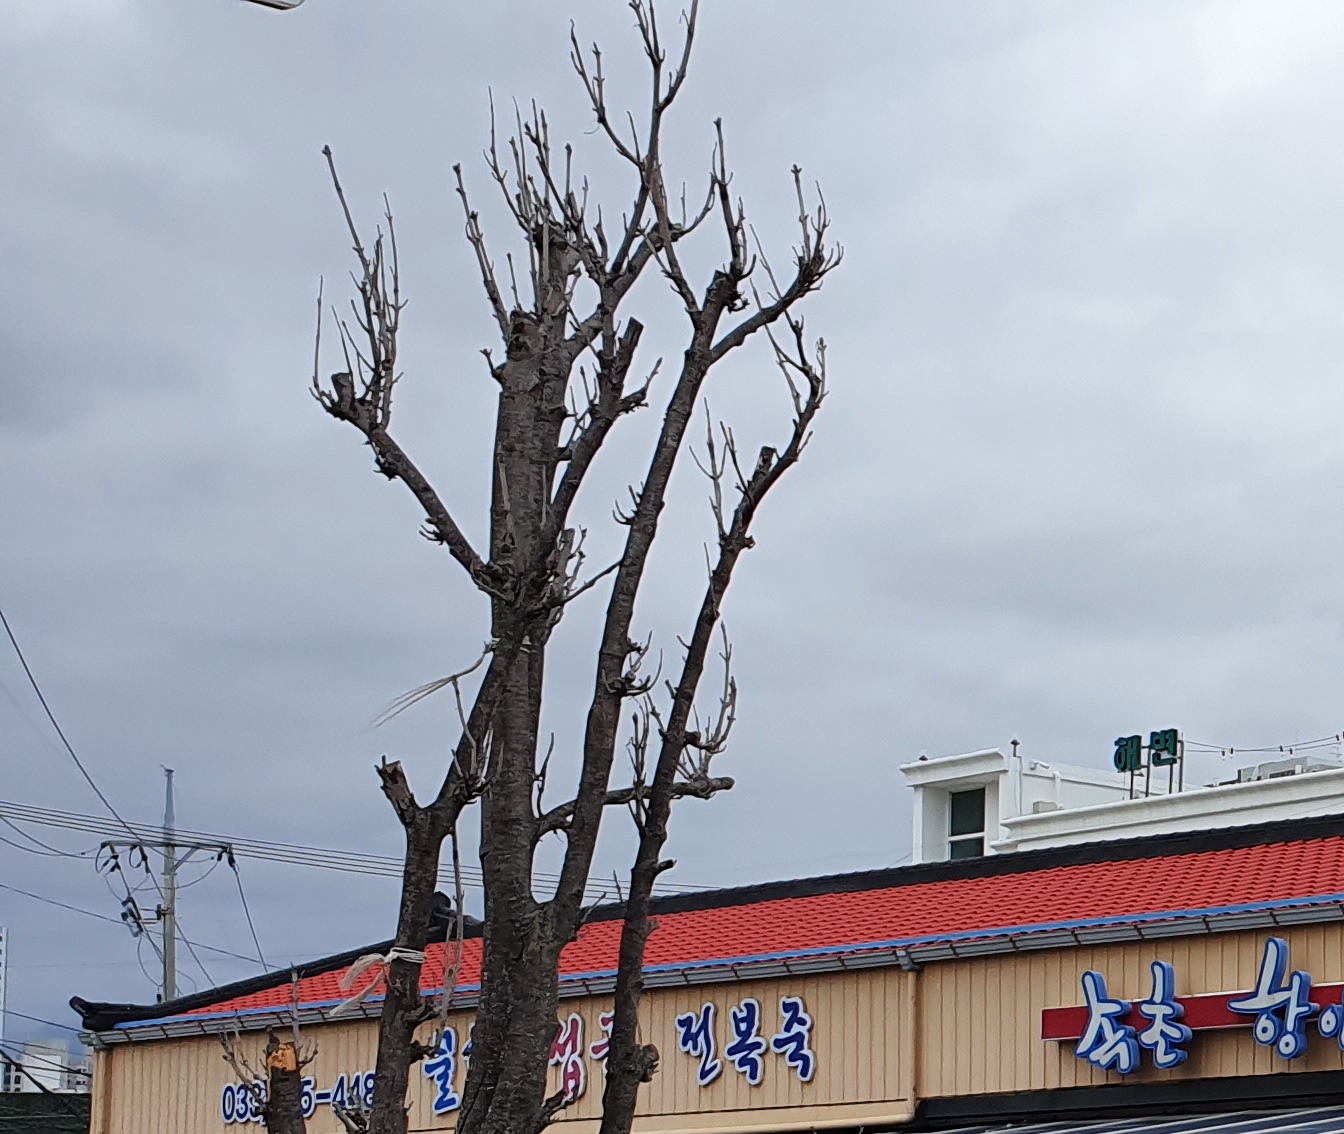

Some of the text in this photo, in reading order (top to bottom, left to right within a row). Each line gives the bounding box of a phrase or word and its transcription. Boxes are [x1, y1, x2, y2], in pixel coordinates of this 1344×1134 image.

[1114, 728, 1178, 772] 해변
[676, 995, 813, 1086] 전복죽
[1075, 961, 1192, 1074] 속초
